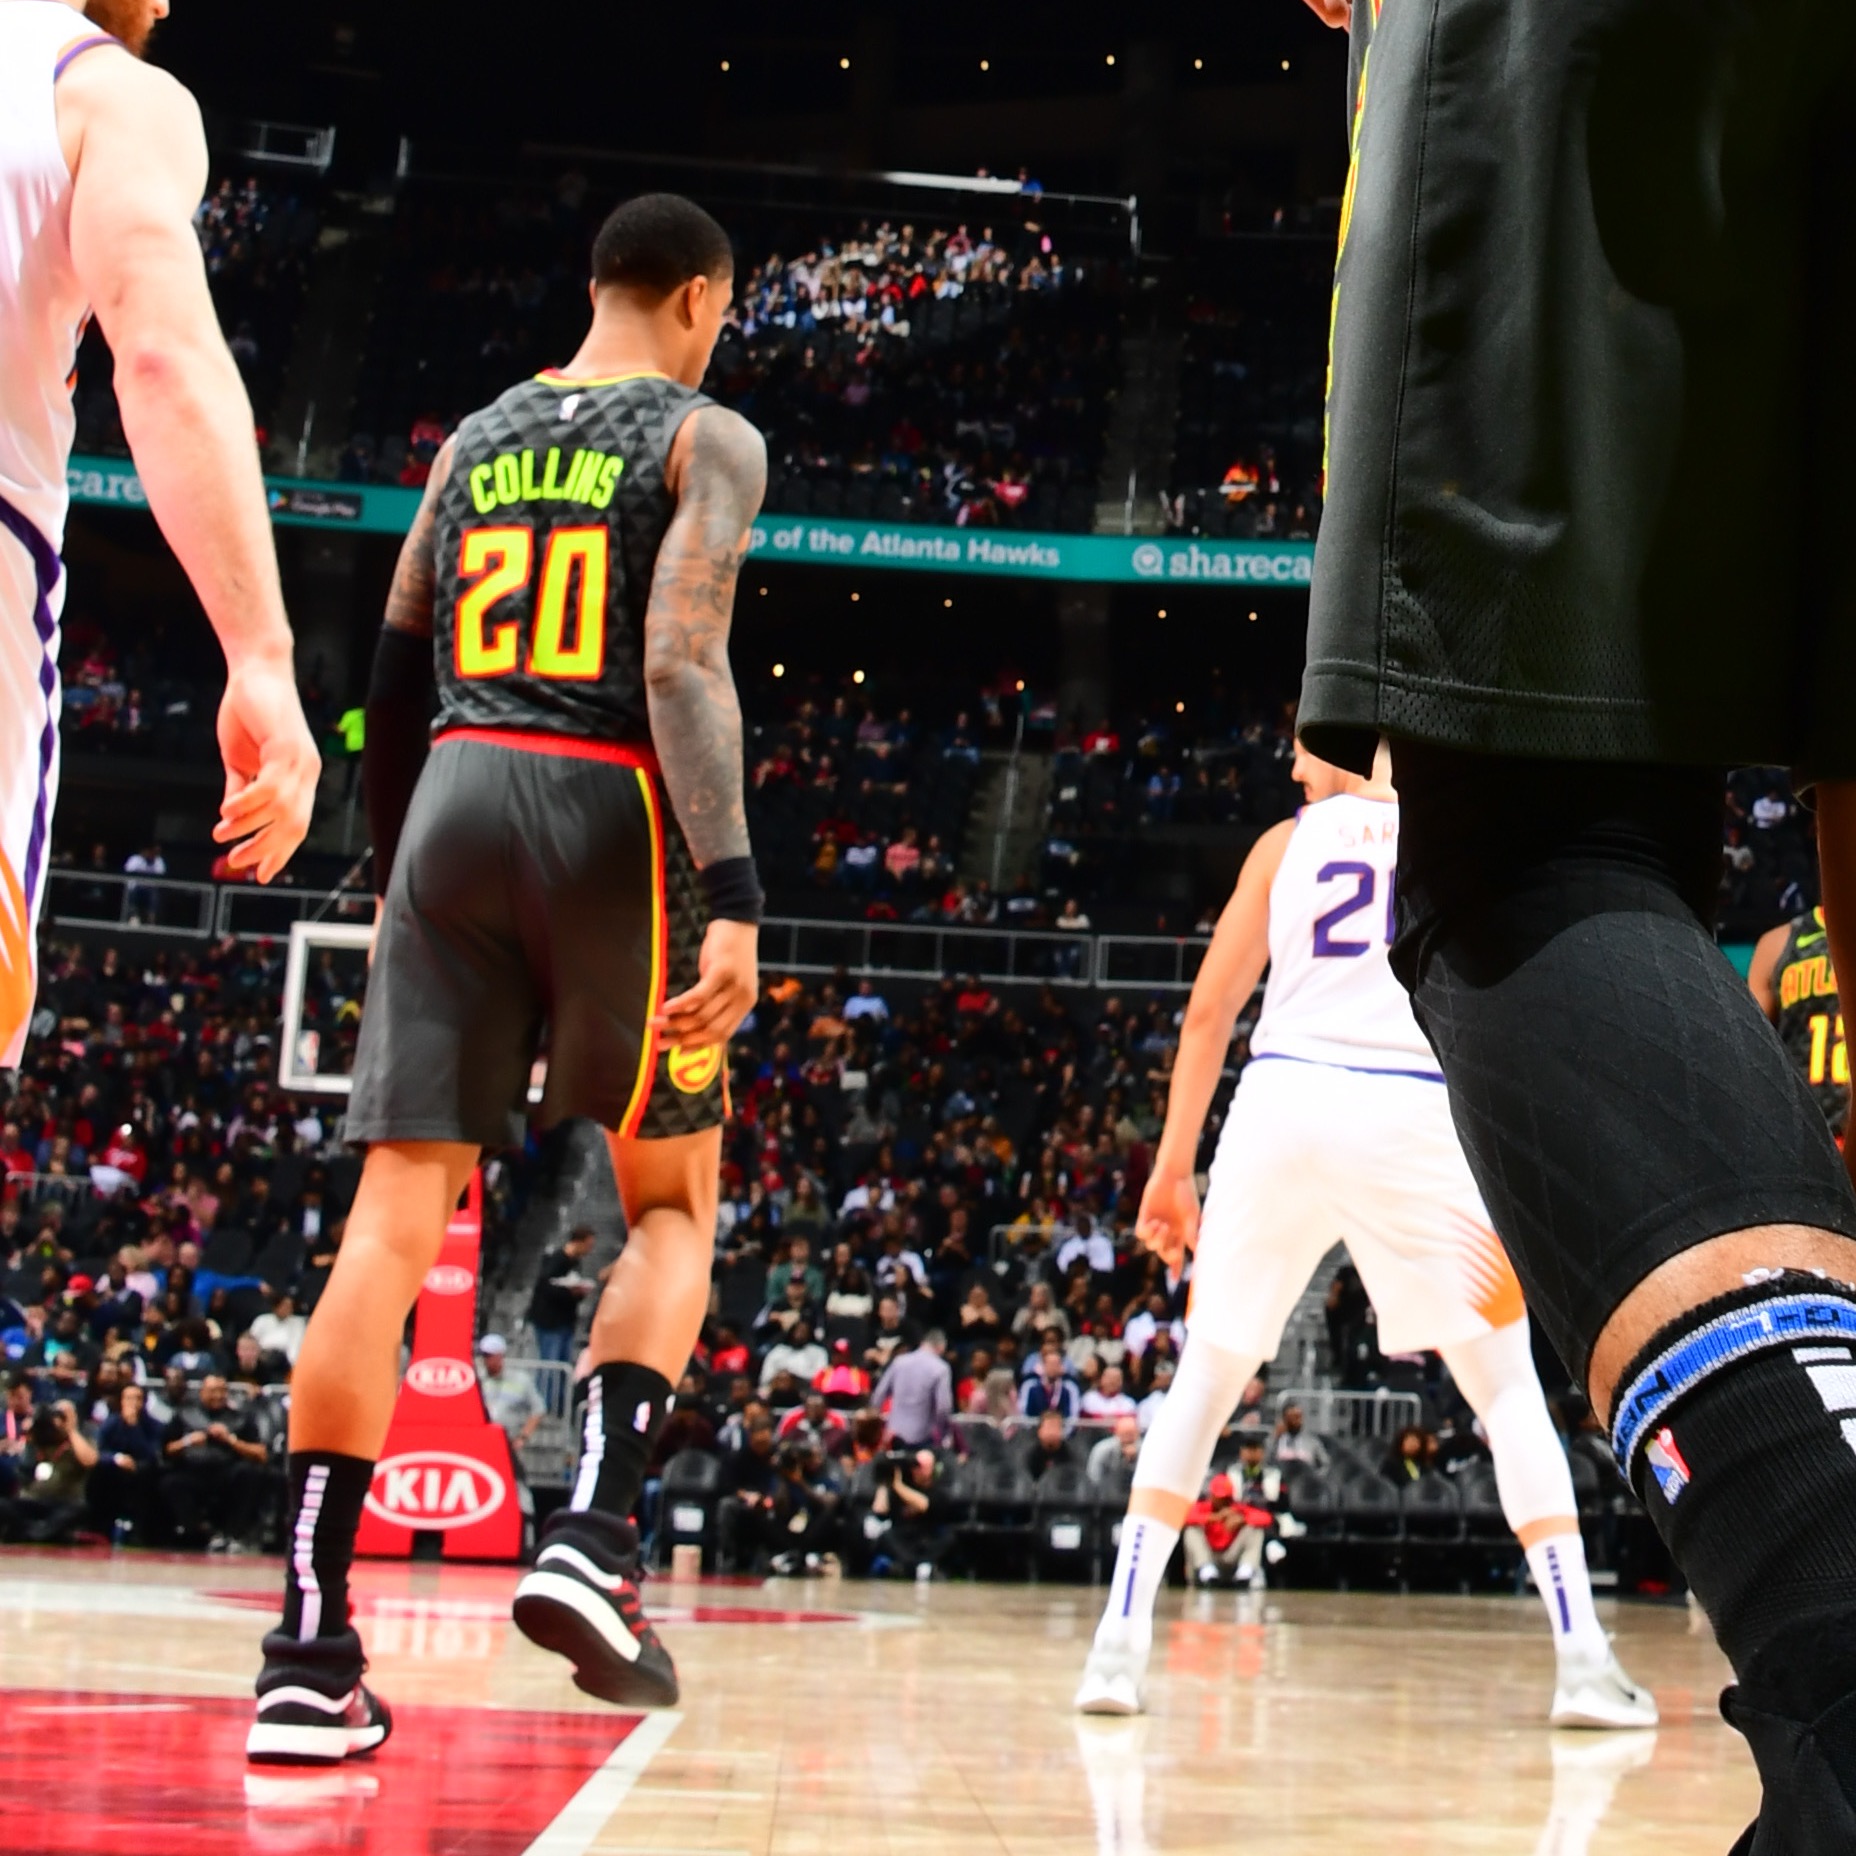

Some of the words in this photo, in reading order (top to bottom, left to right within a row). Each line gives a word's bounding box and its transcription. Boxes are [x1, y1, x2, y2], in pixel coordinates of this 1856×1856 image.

[469, 446, 625, 515] COLLINS
[774, 524, 803, 552] of
[809, 528, 854, 554] the
[859, 530, 960, 561] Atlanta
[966, 538, 1061, 568] Hawks
[453, 525, 610, 681] 20
[1312, 860, 1397, 958] 2
[383, 1468, 481, 1513] KIA
